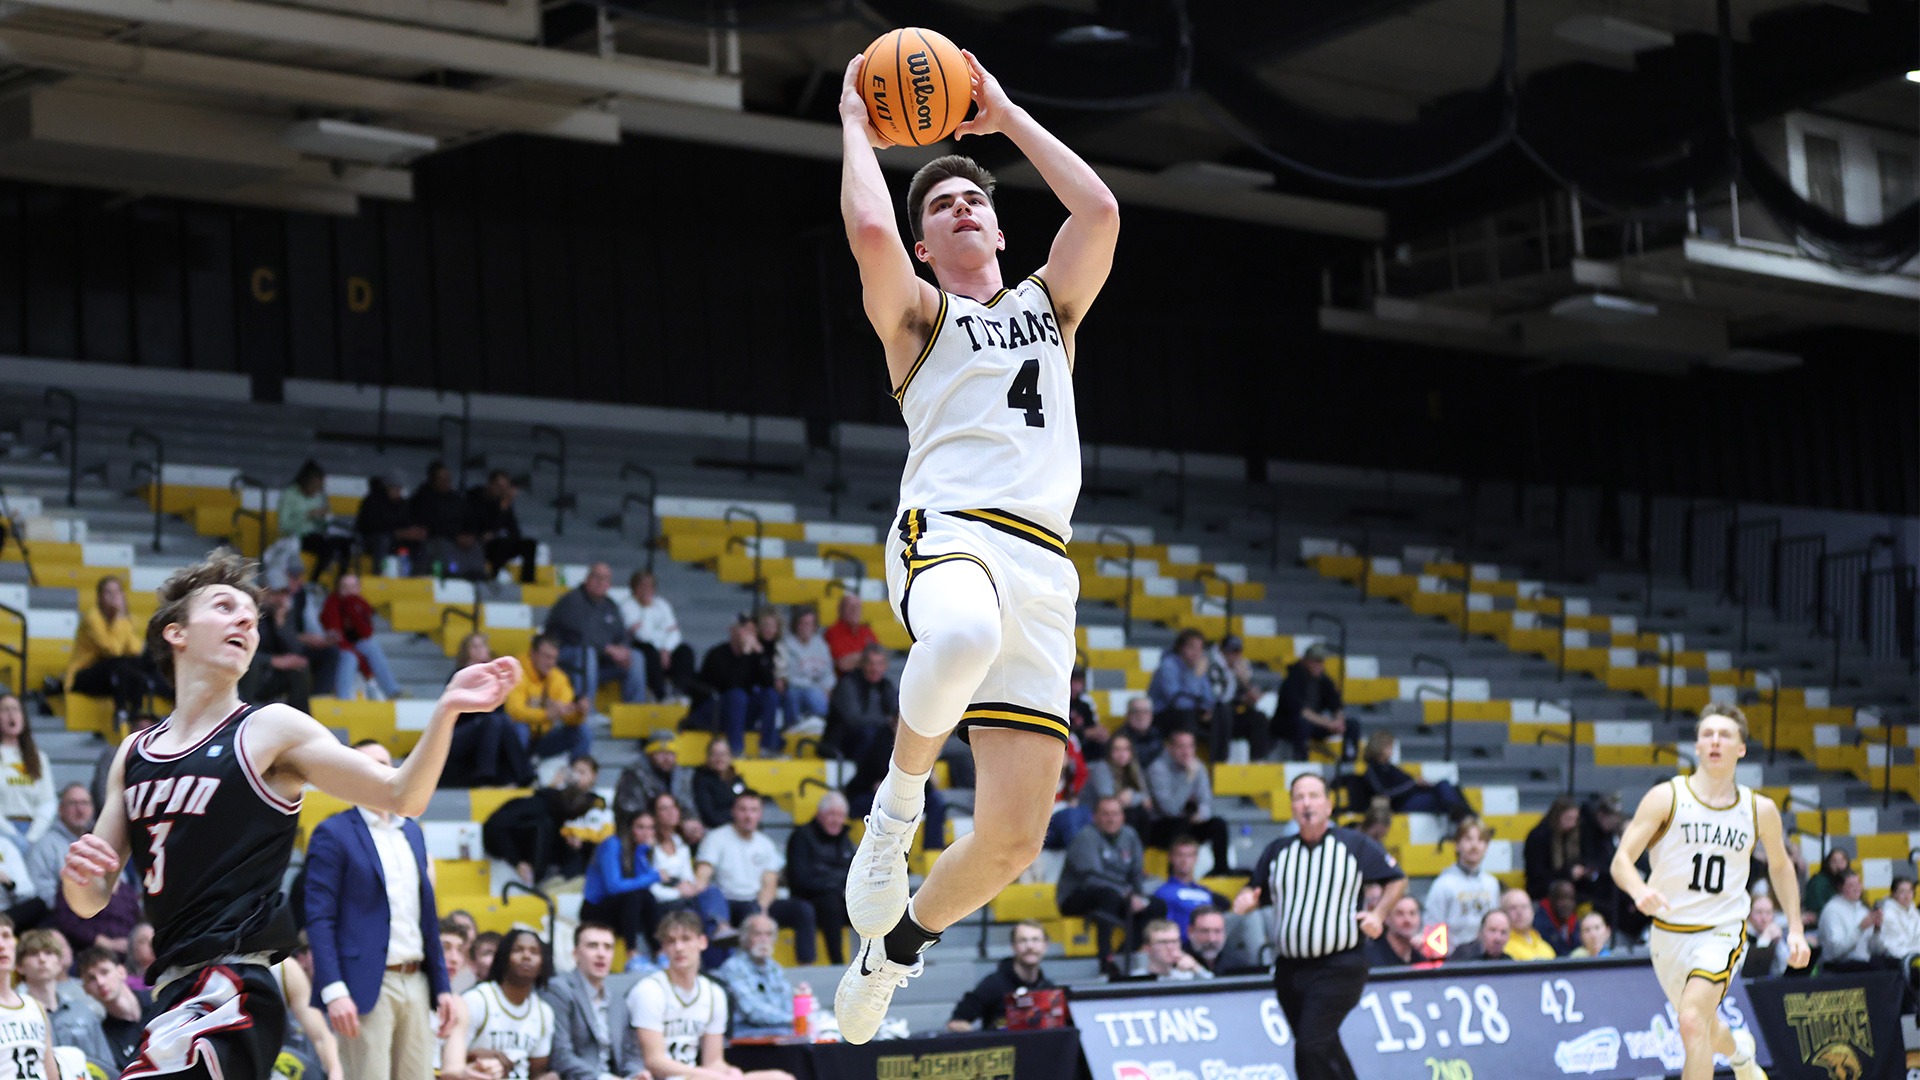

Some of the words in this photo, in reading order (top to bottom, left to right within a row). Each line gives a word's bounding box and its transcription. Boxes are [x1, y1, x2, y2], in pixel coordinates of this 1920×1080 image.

[907, 51, 934, 131] Wilson
[252, 267, 276, 302] C
[348, 278, 372, 311] D
[956, 310, 1059, 352] TITANS
[1007, 358, 1045, 428] 4
[143, 820, 175, 897] 3
[1681, 823, 1748, 852] TITANS
[1688, 852, 1725, 894] 10
[1094, 1006, 1219, 1047] TITANS
[1360, 984, 1510, 1053] 15:28
[1540, 979, 1584, 1024] 42
[12, 1047, 40, 1079] 12
